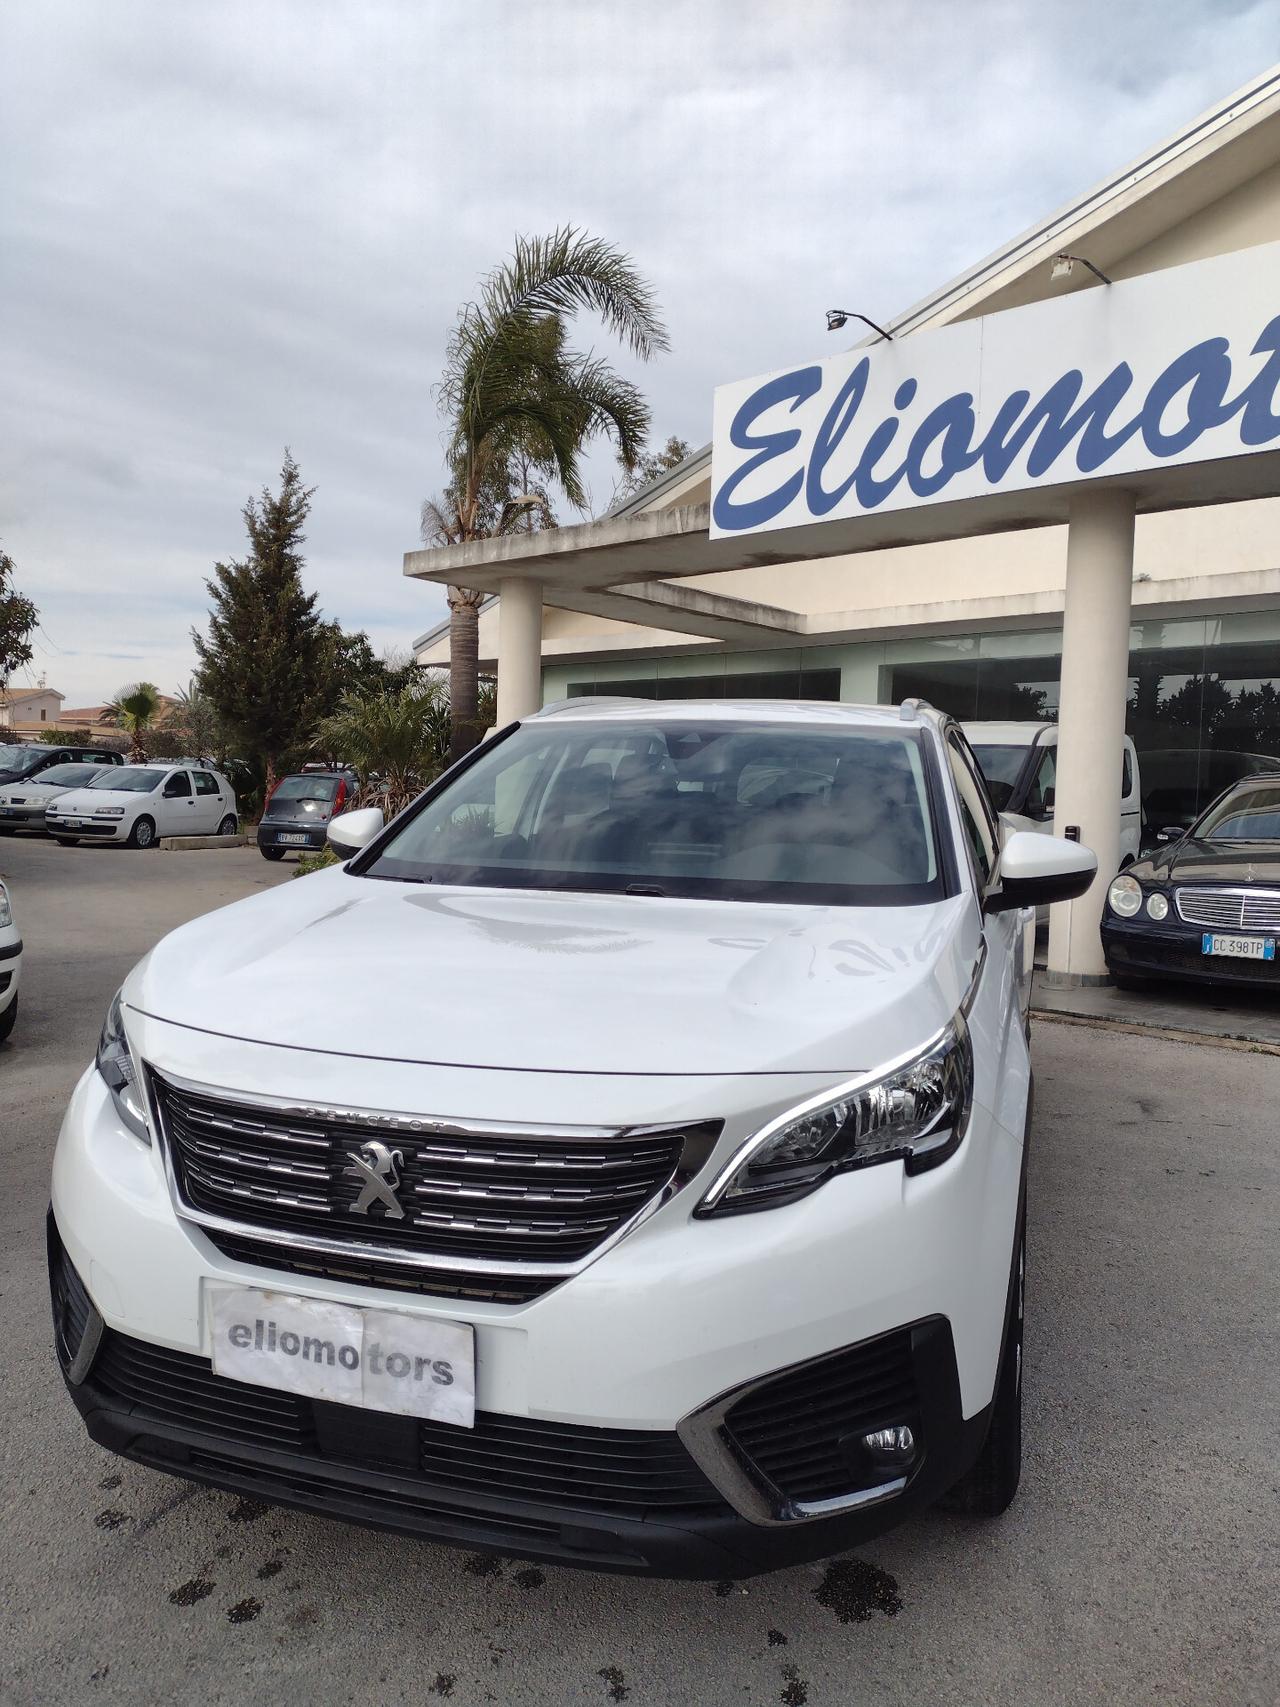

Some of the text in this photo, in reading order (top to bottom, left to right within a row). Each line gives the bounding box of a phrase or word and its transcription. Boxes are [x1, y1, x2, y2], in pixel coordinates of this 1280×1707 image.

[1213, 939, 1226, 952] CC
[305, 1107, 444, 1132] PEUGEOT
[228, 1319, 455, 1386] eliomotors
